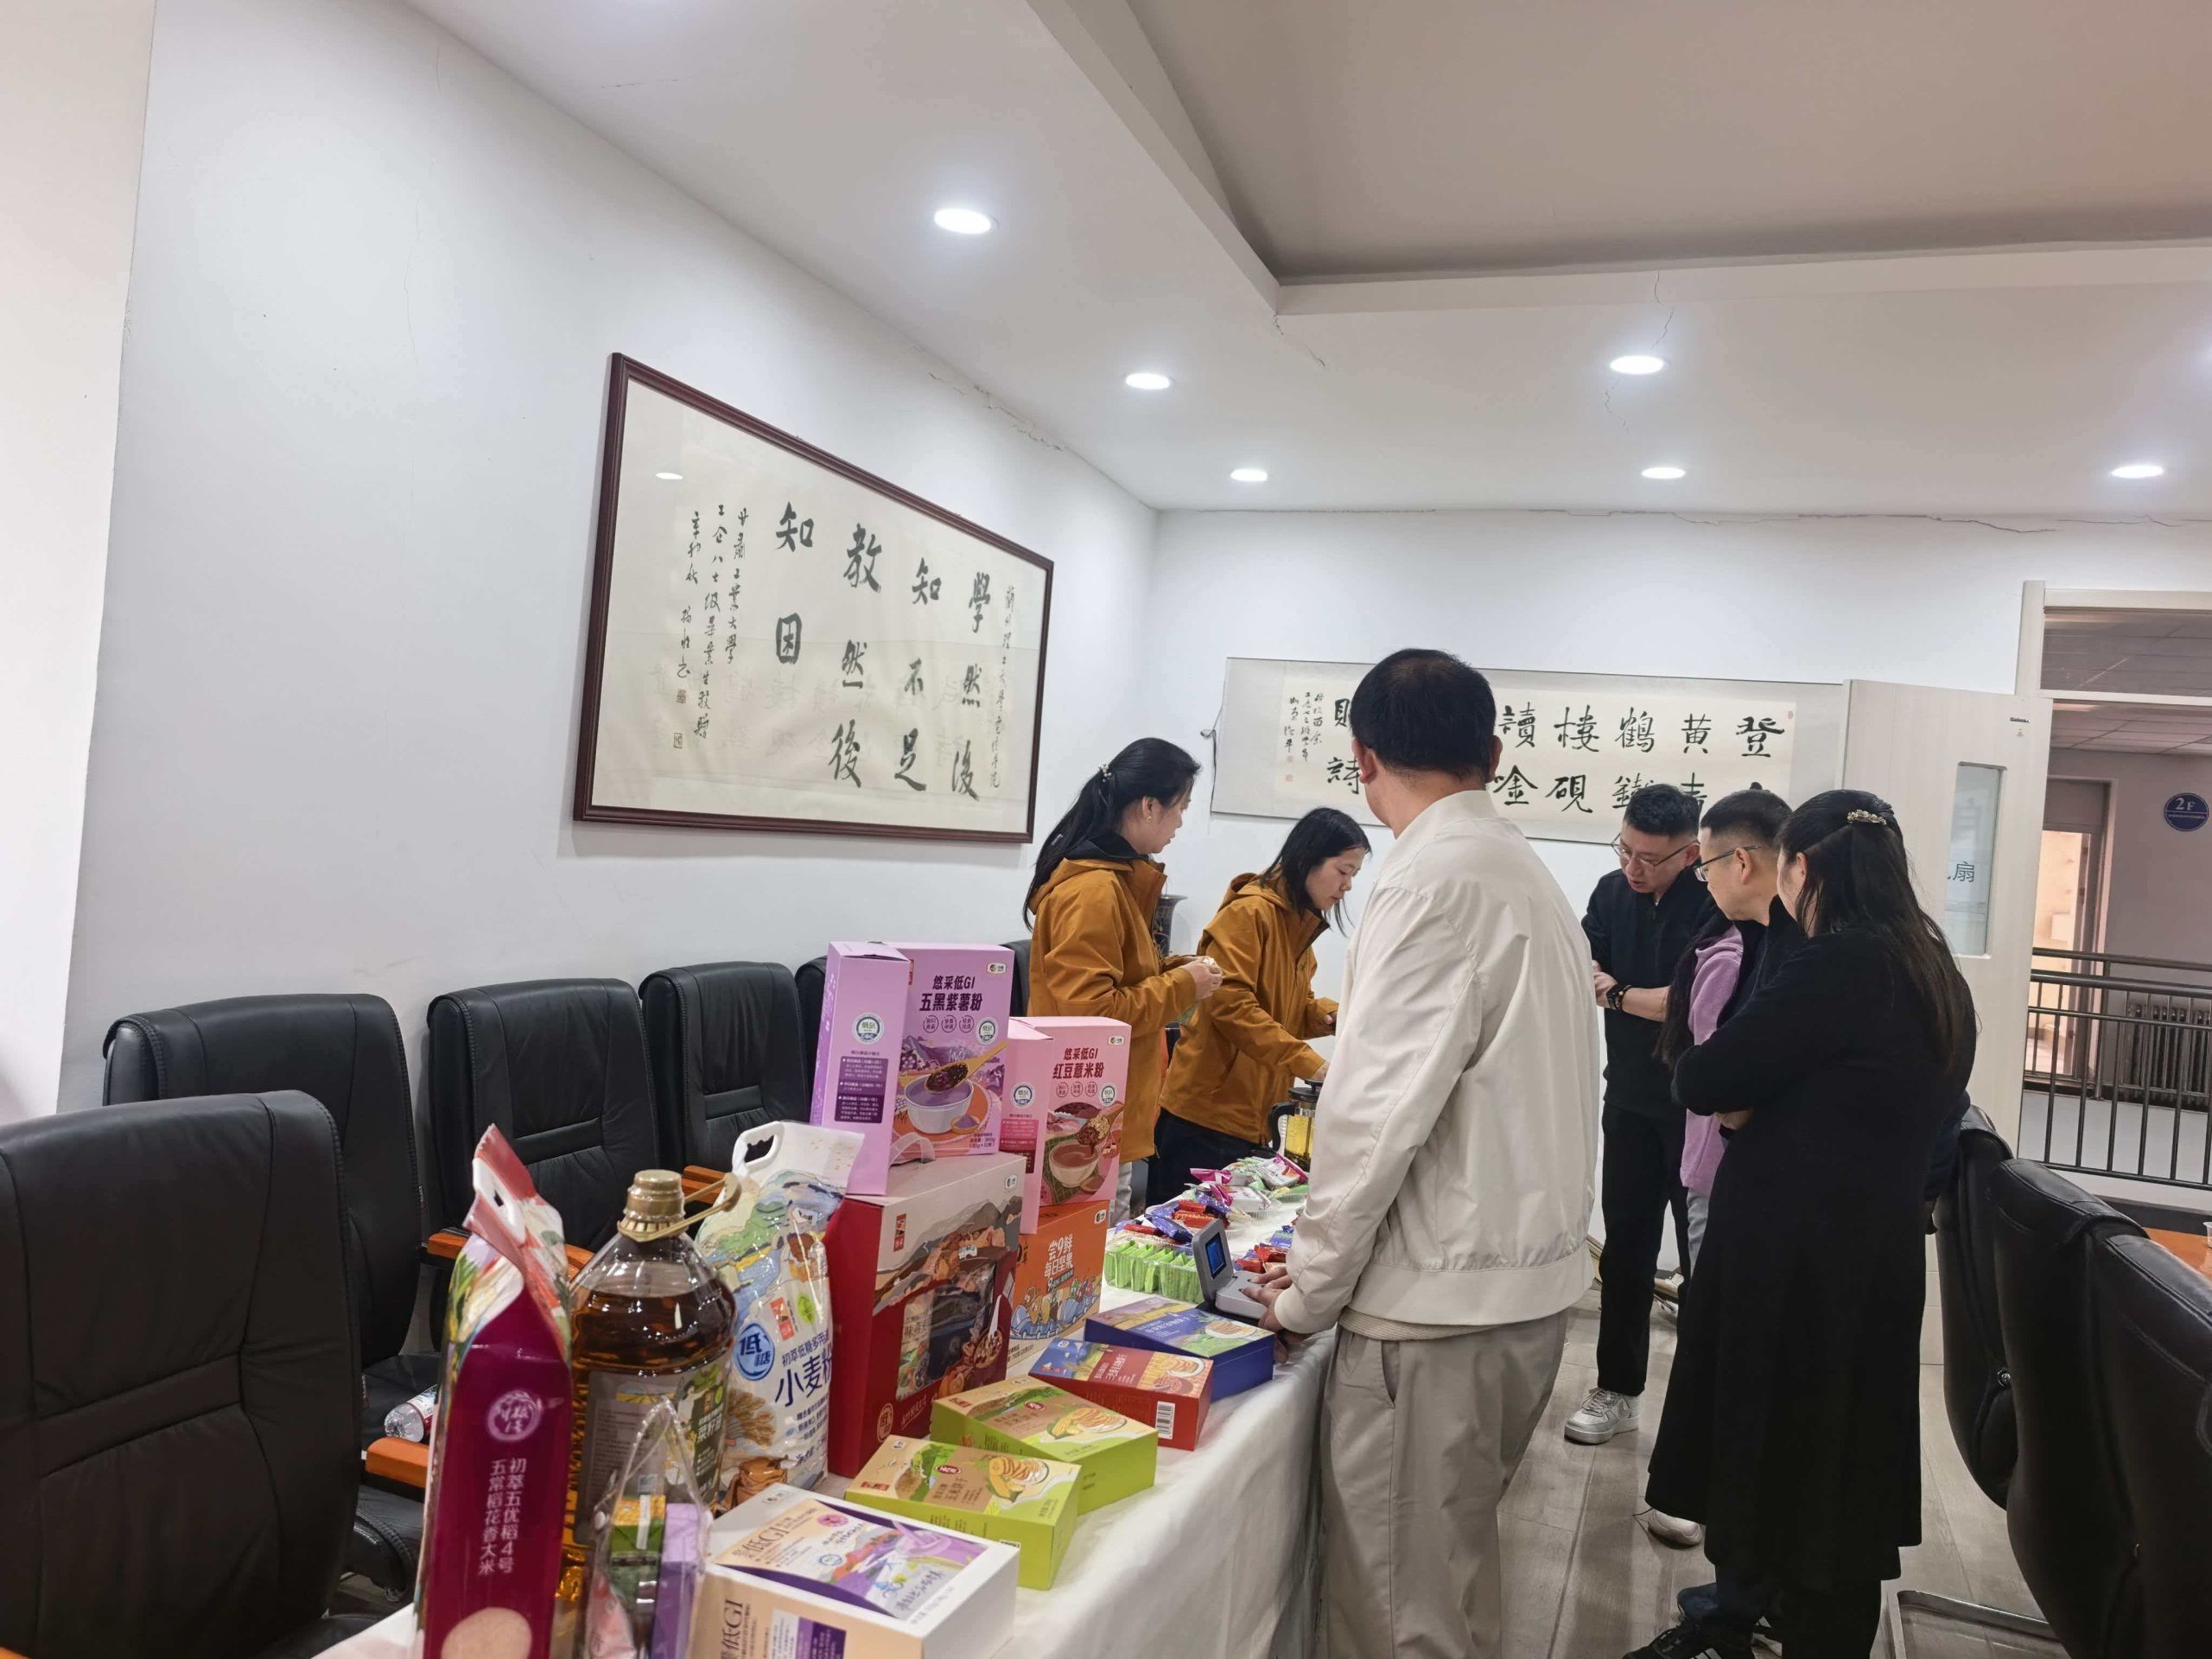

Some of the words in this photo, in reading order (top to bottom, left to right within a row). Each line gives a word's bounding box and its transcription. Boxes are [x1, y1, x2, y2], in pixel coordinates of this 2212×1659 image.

[2176, 798, 2196, 810] 2F
[1947, 861, 1974, 883] 扇
[919, 992, 982, 1012] 五黑紫薯粉
